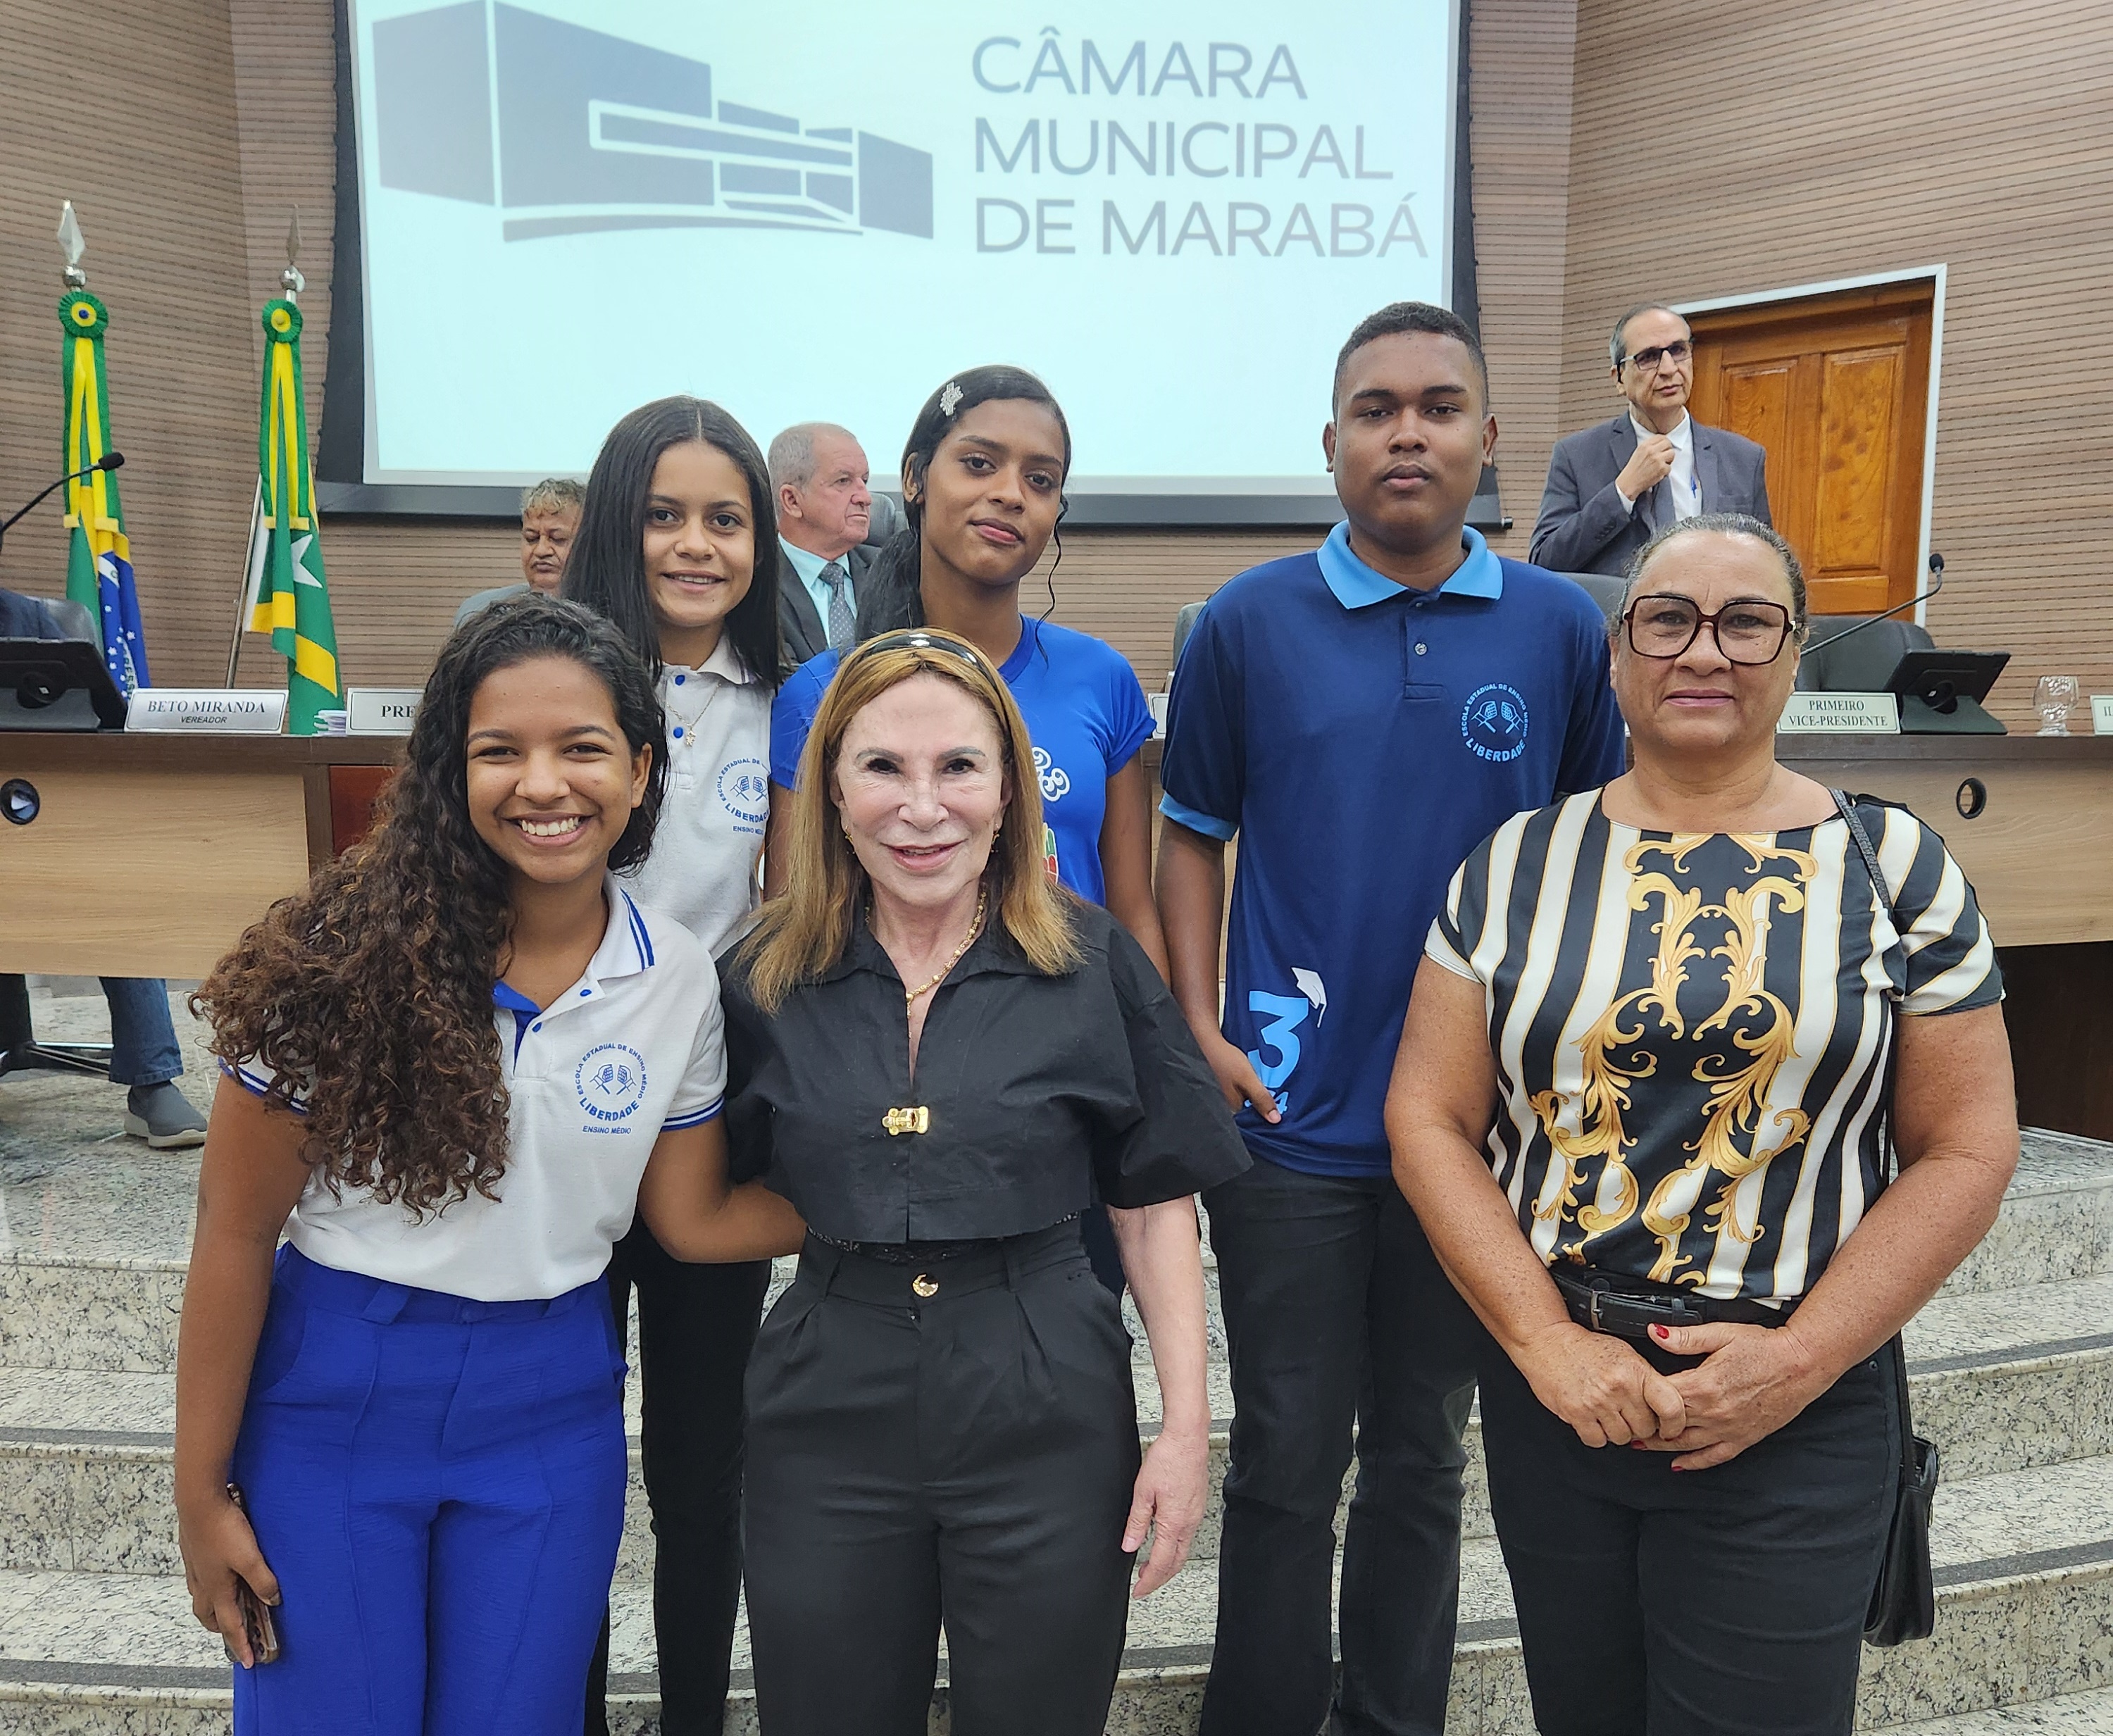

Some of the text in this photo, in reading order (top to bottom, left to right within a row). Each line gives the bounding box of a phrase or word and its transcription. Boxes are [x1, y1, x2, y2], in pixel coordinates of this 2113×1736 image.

[971, 25, 1308, 100] CÂMARA
[975, 117, 1394, 180] MUNICIPAL
[976, 192, 1429, 258] DE MARABÁ
[147, 700, 266, 713] BETO MIRANDA
[1461, 706, 1470, 737] ESCOLA
[1466, 683, 1497, 705] ESTADUAL
[1809, 700, 1864, 711] PRIMEIRO
[1788, 716, 1888, 726] VICE-PRESIDENTE
[1466, 737, 1526, 762] LIBERDADE
[721, 758, 751, 775] ESTADUAL
[717, 775, 726, 801] ESCOLA
[1249, 991, 1309, 1087] 3
[575, 1063, 584, 1095] ESCOLA
[582, 1043, 616, 1062] ESTADUAL
[629, 1048, 645, 1071] ENSINO
[579, 1097, 640, 1121] LIBERDADE
[582, 1125, 610, 1134] ENSINO
